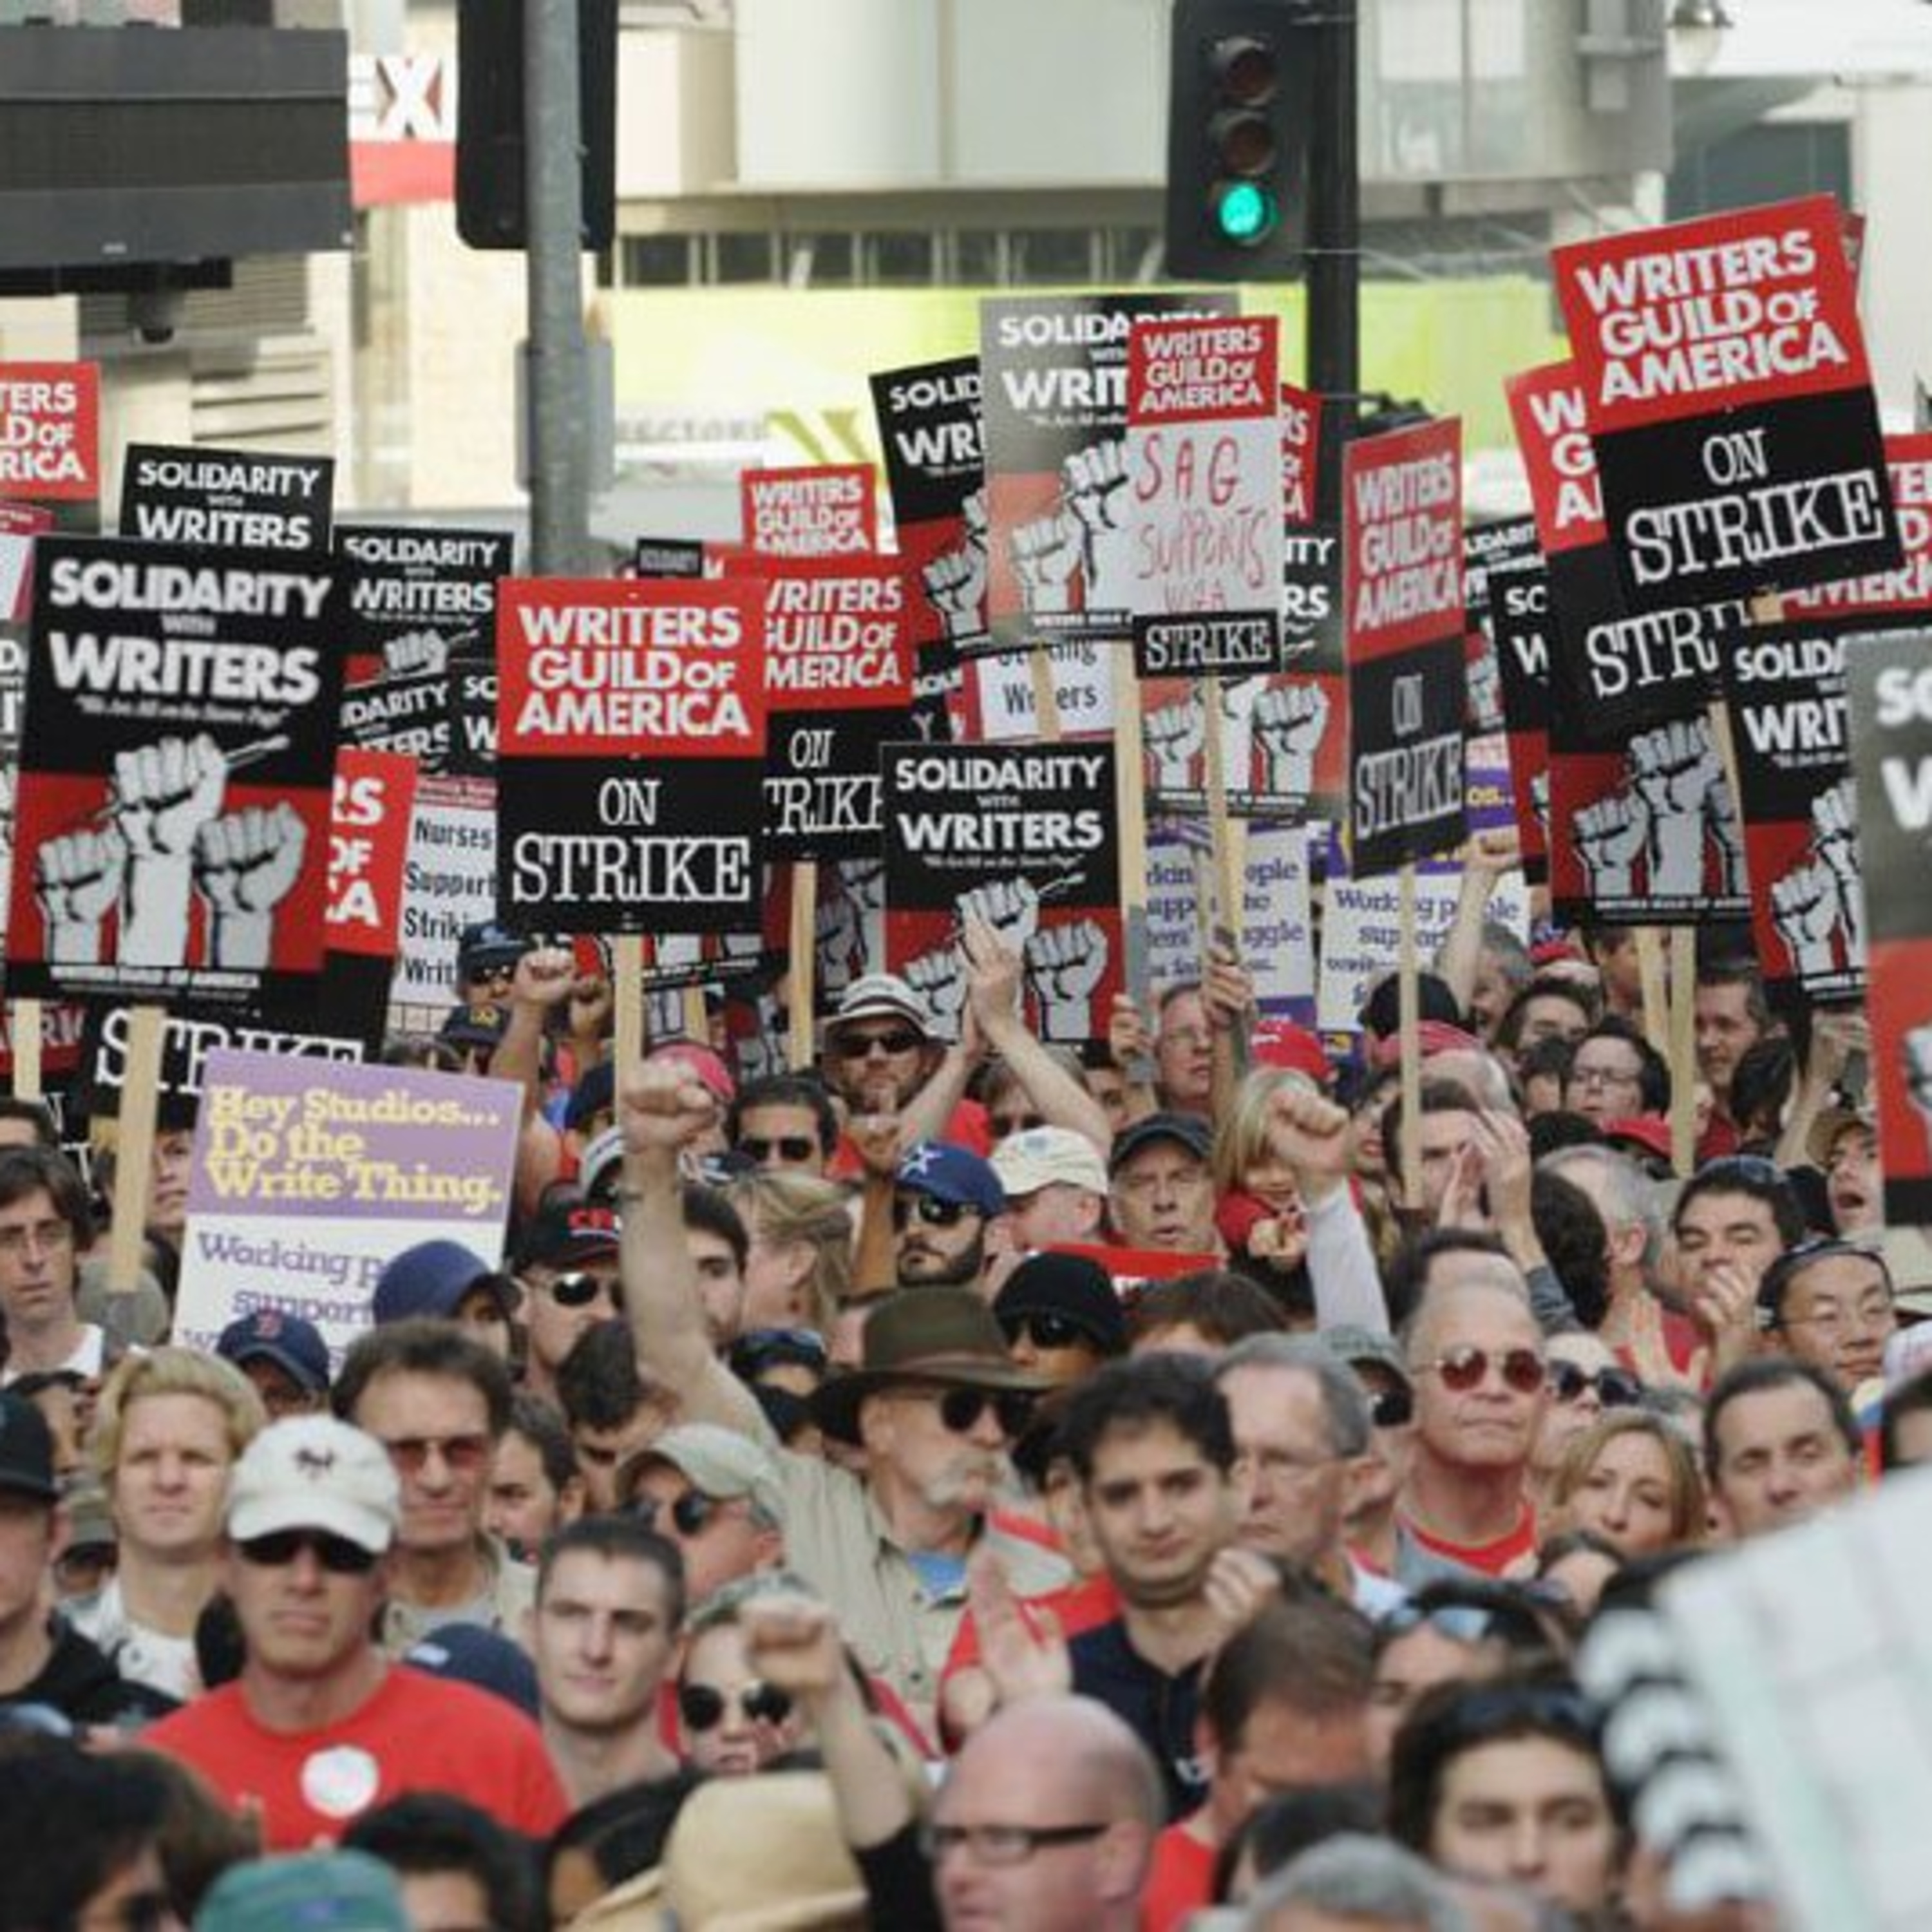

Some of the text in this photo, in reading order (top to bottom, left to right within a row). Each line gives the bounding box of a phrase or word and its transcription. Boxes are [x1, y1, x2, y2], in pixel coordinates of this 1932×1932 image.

[1575, 229, 1817, 314] WRITERS
[1142, 325, 1263, 359] WRITERS
[1600, 287, 1820, 357] GUILD OF
[1146, 357, 1231, 388] GUILD
[1601, 321, 1849, 406] AMERICA
[1139, 383, 1264, 413] AMERICA
[137, 460, 319, 497] SOLIDARITY
[1703, 428, 1770, 486] ON
[751, 475, 864, 506] WRITERS
[1354, 451, 1455, 525] WRITERS
[137, 504, 311, 549] WRITERS
[755, 528, 871, 556] AMERICA
[1360, 515, 1431, 577] GUILD
[1626, 469, 1886, 585] STRIKE
[343, 536, 500, 568] SOLIDARITY
[50, 558, 332, 618] SOLIDARITY
[351, 579, 495, 612] WRITERS
[1354, 558, 1459, 633] AMERICA
[161, 614, 216, 635] WITH
[518, 606, 743, 648] WRITERS
[862, 622, 898, 650] OF
[1146, 619, 1271, 669] STRIKE
[48, 632, 320, 704] WRITERS
[527, 649, 737, 690] GUILD OF
[515, 691, 752, 737] AMERICA
[1392, 674, 1423, 737] ON
[790, 730, 835, 768] ON
[895, 755, 1106, 791] SOLIDARITY
[1356, 731, 1462, 840] STRIKE
[599, 777, 662, 826] ON
[415, 818, 493, 850] Nurses
[896, 810, 1104, 851] WRITERS
[513, 831, 751, 904] STRIKE
[207, 1085, 500, 1130] Hey Studios...
[211, 1122, 364, 1161] Do the
[206, 1159, 502, 1213] Write Thing.
[198, 1232, 350, 1285] Working
